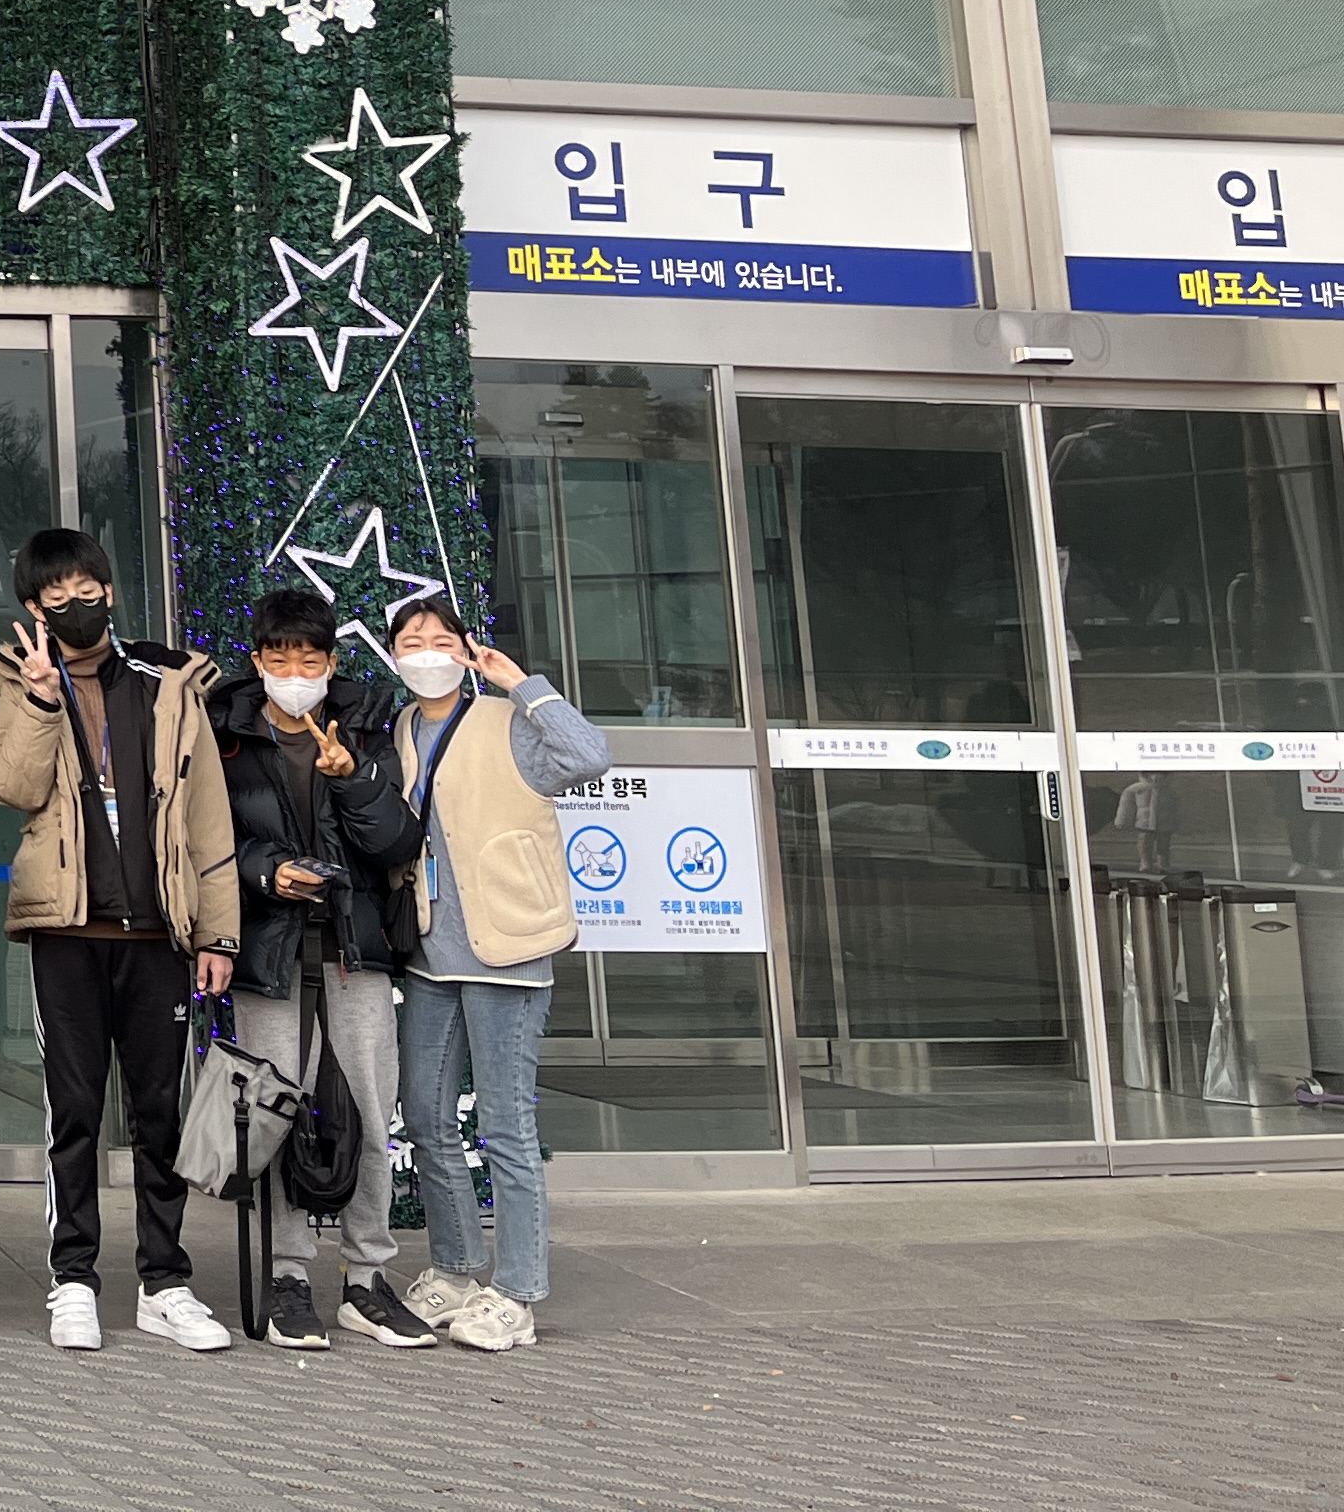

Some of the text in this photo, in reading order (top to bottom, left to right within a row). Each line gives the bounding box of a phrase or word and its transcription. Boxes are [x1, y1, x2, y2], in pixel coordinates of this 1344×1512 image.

[507, 243, 844, 294] 매표소는 내부에 있습니다.
[1178, 268, 1304, 308] 매표소는
[955, 741, 997, 752] SCIPIA
[611, 777, 648, 799] 항목
[603, 800, 630, 812] Items
[575, 899, 626, 915] 반려동물
[685, 901, 697, 915] 및
